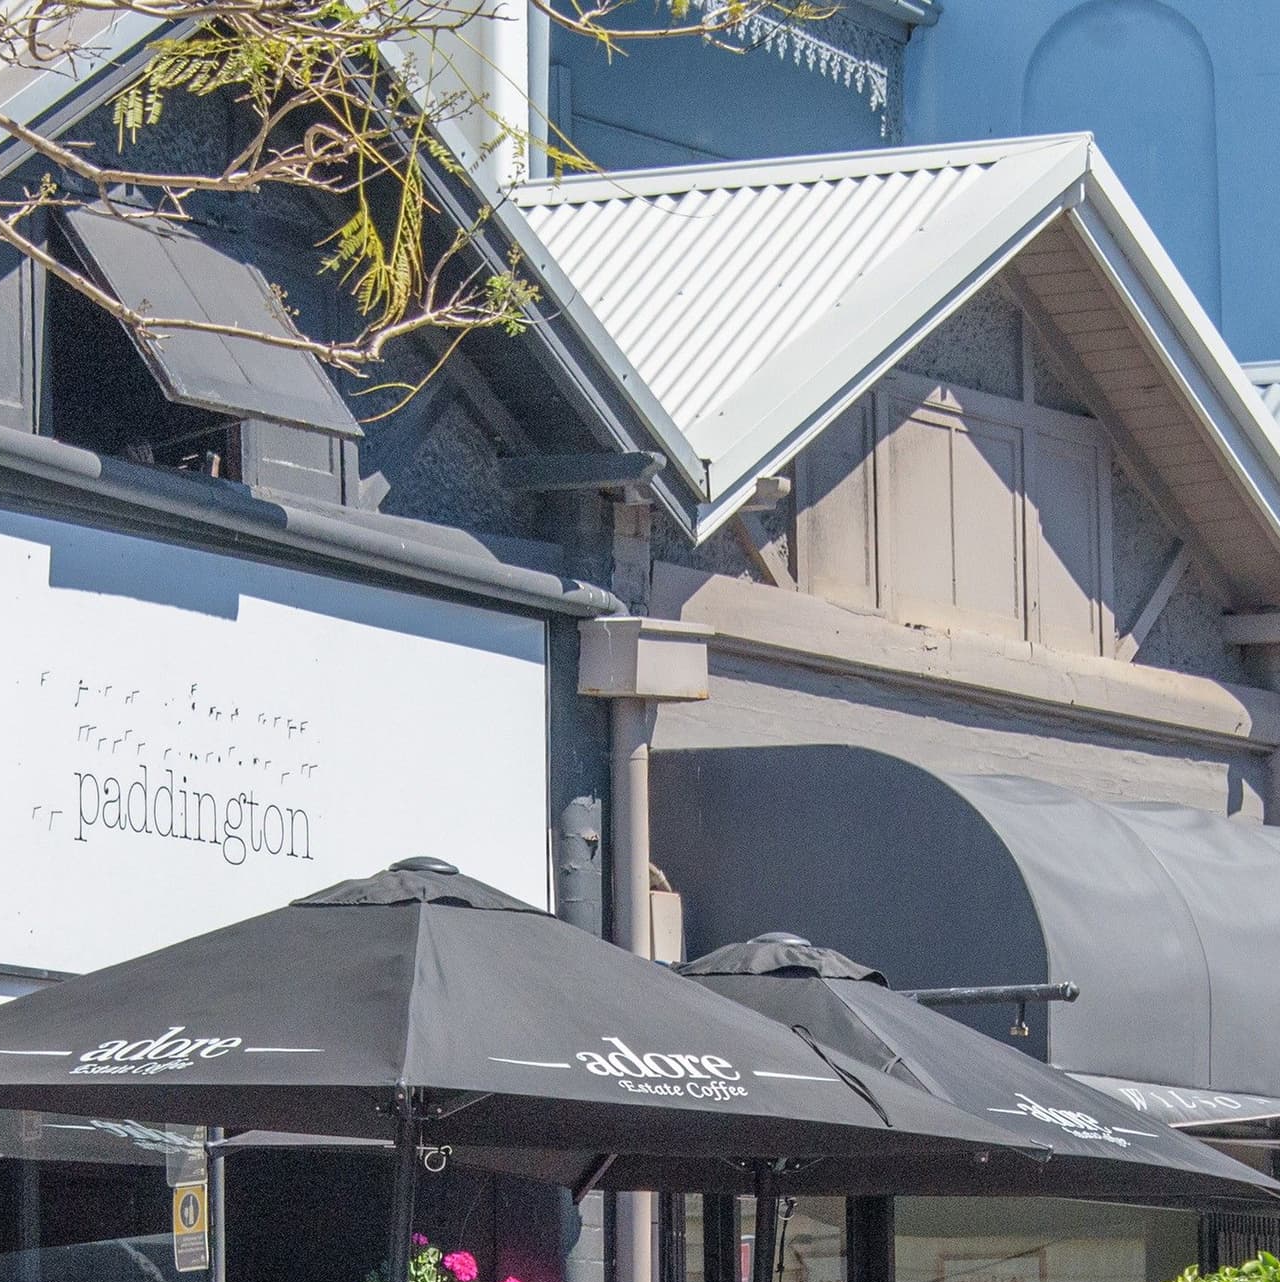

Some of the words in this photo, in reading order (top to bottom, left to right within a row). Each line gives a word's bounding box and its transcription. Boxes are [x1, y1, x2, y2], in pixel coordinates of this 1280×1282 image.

[74, 765, 314, 865] paddington
[80, 1026, 242, 1062] adore
[576, 1037, 740, 1081] adore
[619, 1080, 684, 1096] Estate
[686, 1081, 748, 1101] Coffee
